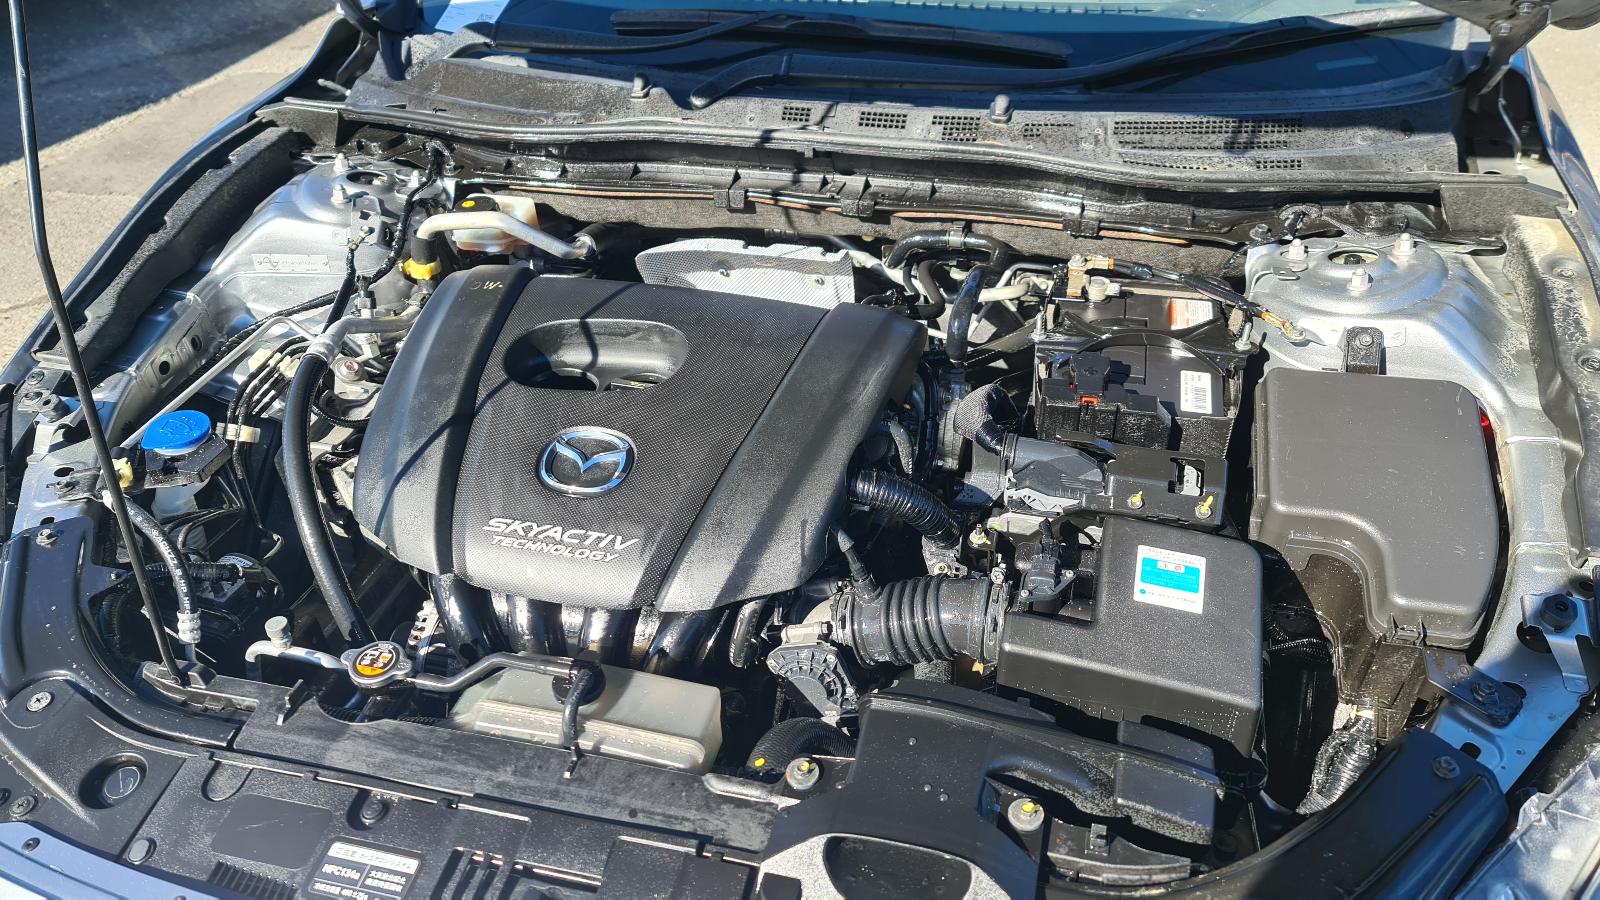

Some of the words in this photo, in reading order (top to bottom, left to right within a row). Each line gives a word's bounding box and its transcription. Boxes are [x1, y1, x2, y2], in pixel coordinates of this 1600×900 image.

[482, 517, 640, 550] SKYACTIV
[491, 535, 621, 562] TECHNOLOGY
[322, 863, 360, 880] HFC134a
